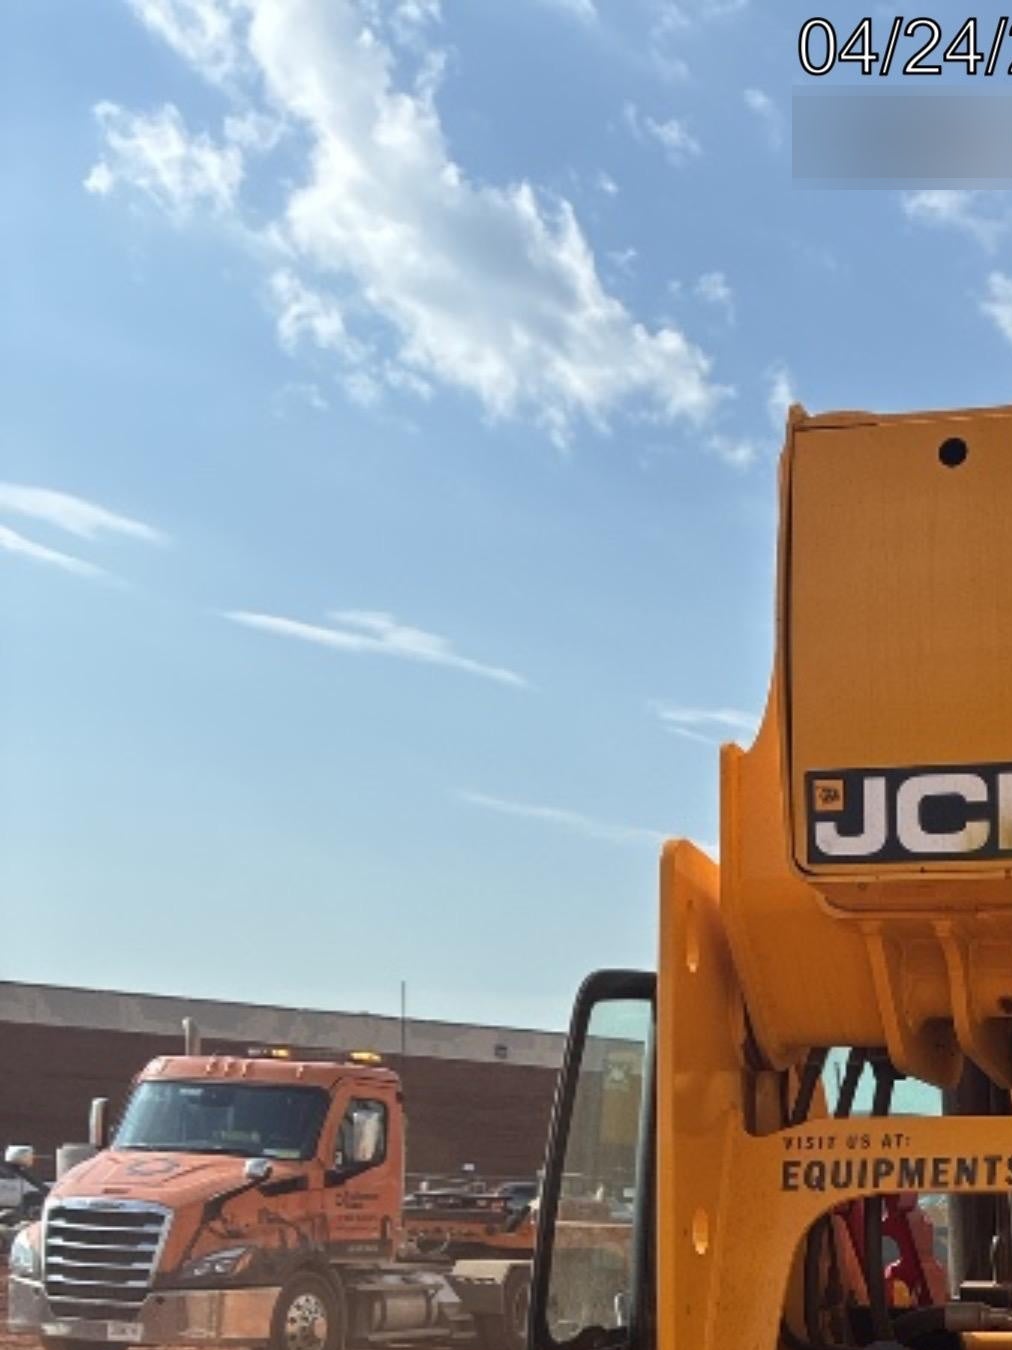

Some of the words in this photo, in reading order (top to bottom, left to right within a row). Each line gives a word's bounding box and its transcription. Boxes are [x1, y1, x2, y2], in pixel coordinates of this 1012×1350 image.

[782, 1136, 837, 1150] VISIT
[846, 1134, 871, 1149] US
[881, 1133, 911, 1149] AT:
